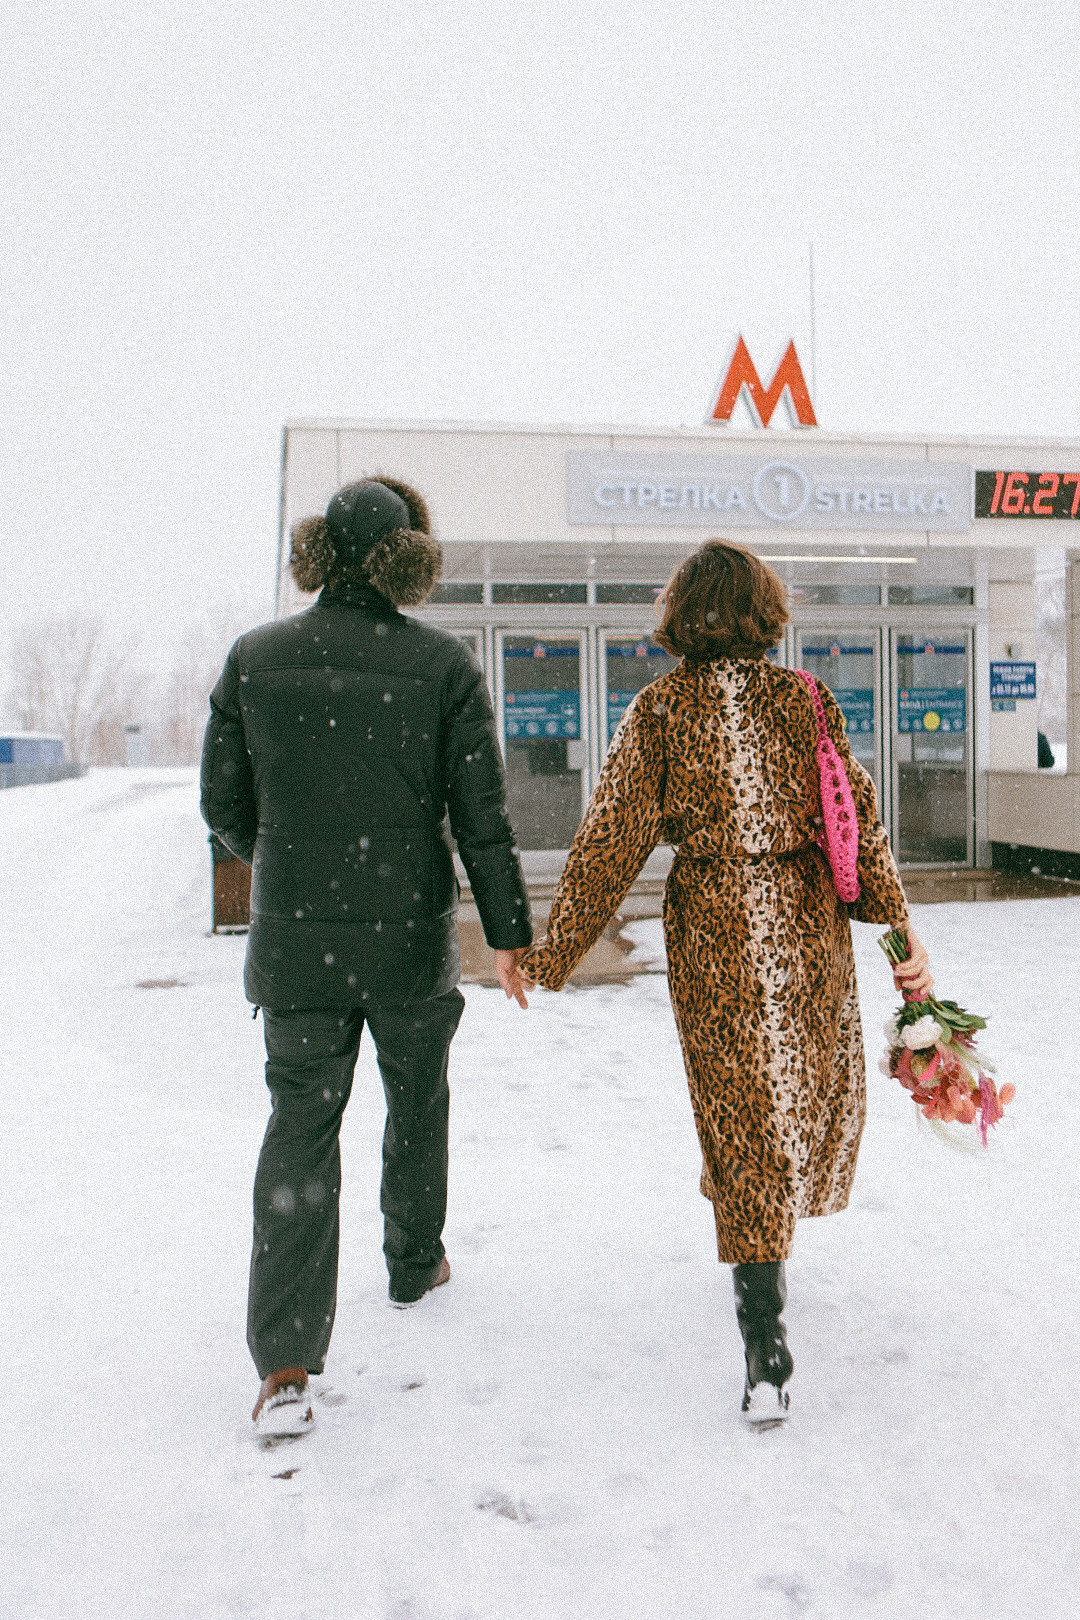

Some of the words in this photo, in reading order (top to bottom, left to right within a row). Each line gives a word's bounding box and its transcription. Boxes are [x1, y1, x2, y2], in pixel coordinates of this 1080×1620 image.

[594, 481, 748, 510] СТРЕЛКА
[775, 475, 790, 506] 1
[814, 485, 951, 515] STRELKA
